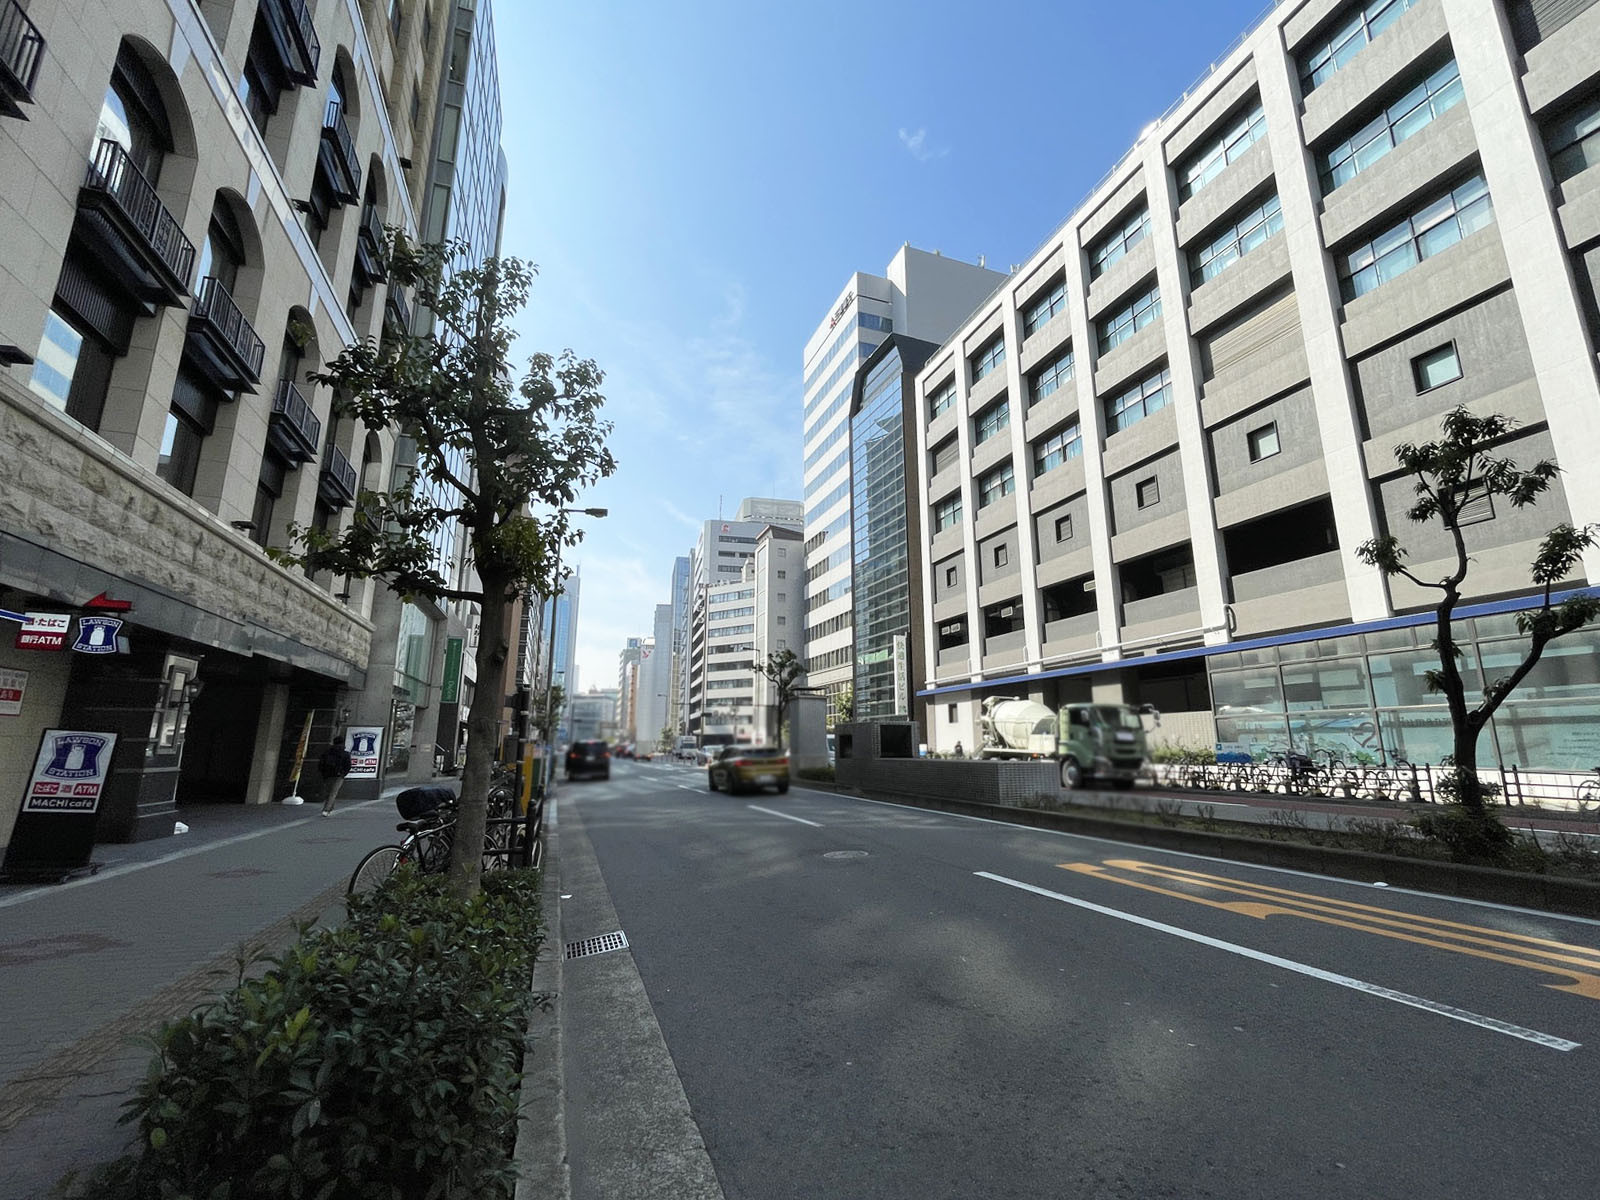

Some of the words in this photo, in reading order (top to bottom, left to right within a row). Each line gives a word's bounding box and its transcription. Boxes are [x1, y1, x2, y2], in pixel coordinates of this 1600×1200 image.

[82, 619, 119, 628] LAWSON
[76, 643, 113, 651] STATION
[57, 736, 104, 747] LAWSON
[47, 767, 94, 777] STATION
[74, 785, 97, 794] ATM
[31, 798, 68, 807] MACHI
[69, 798, 93, 808] café
